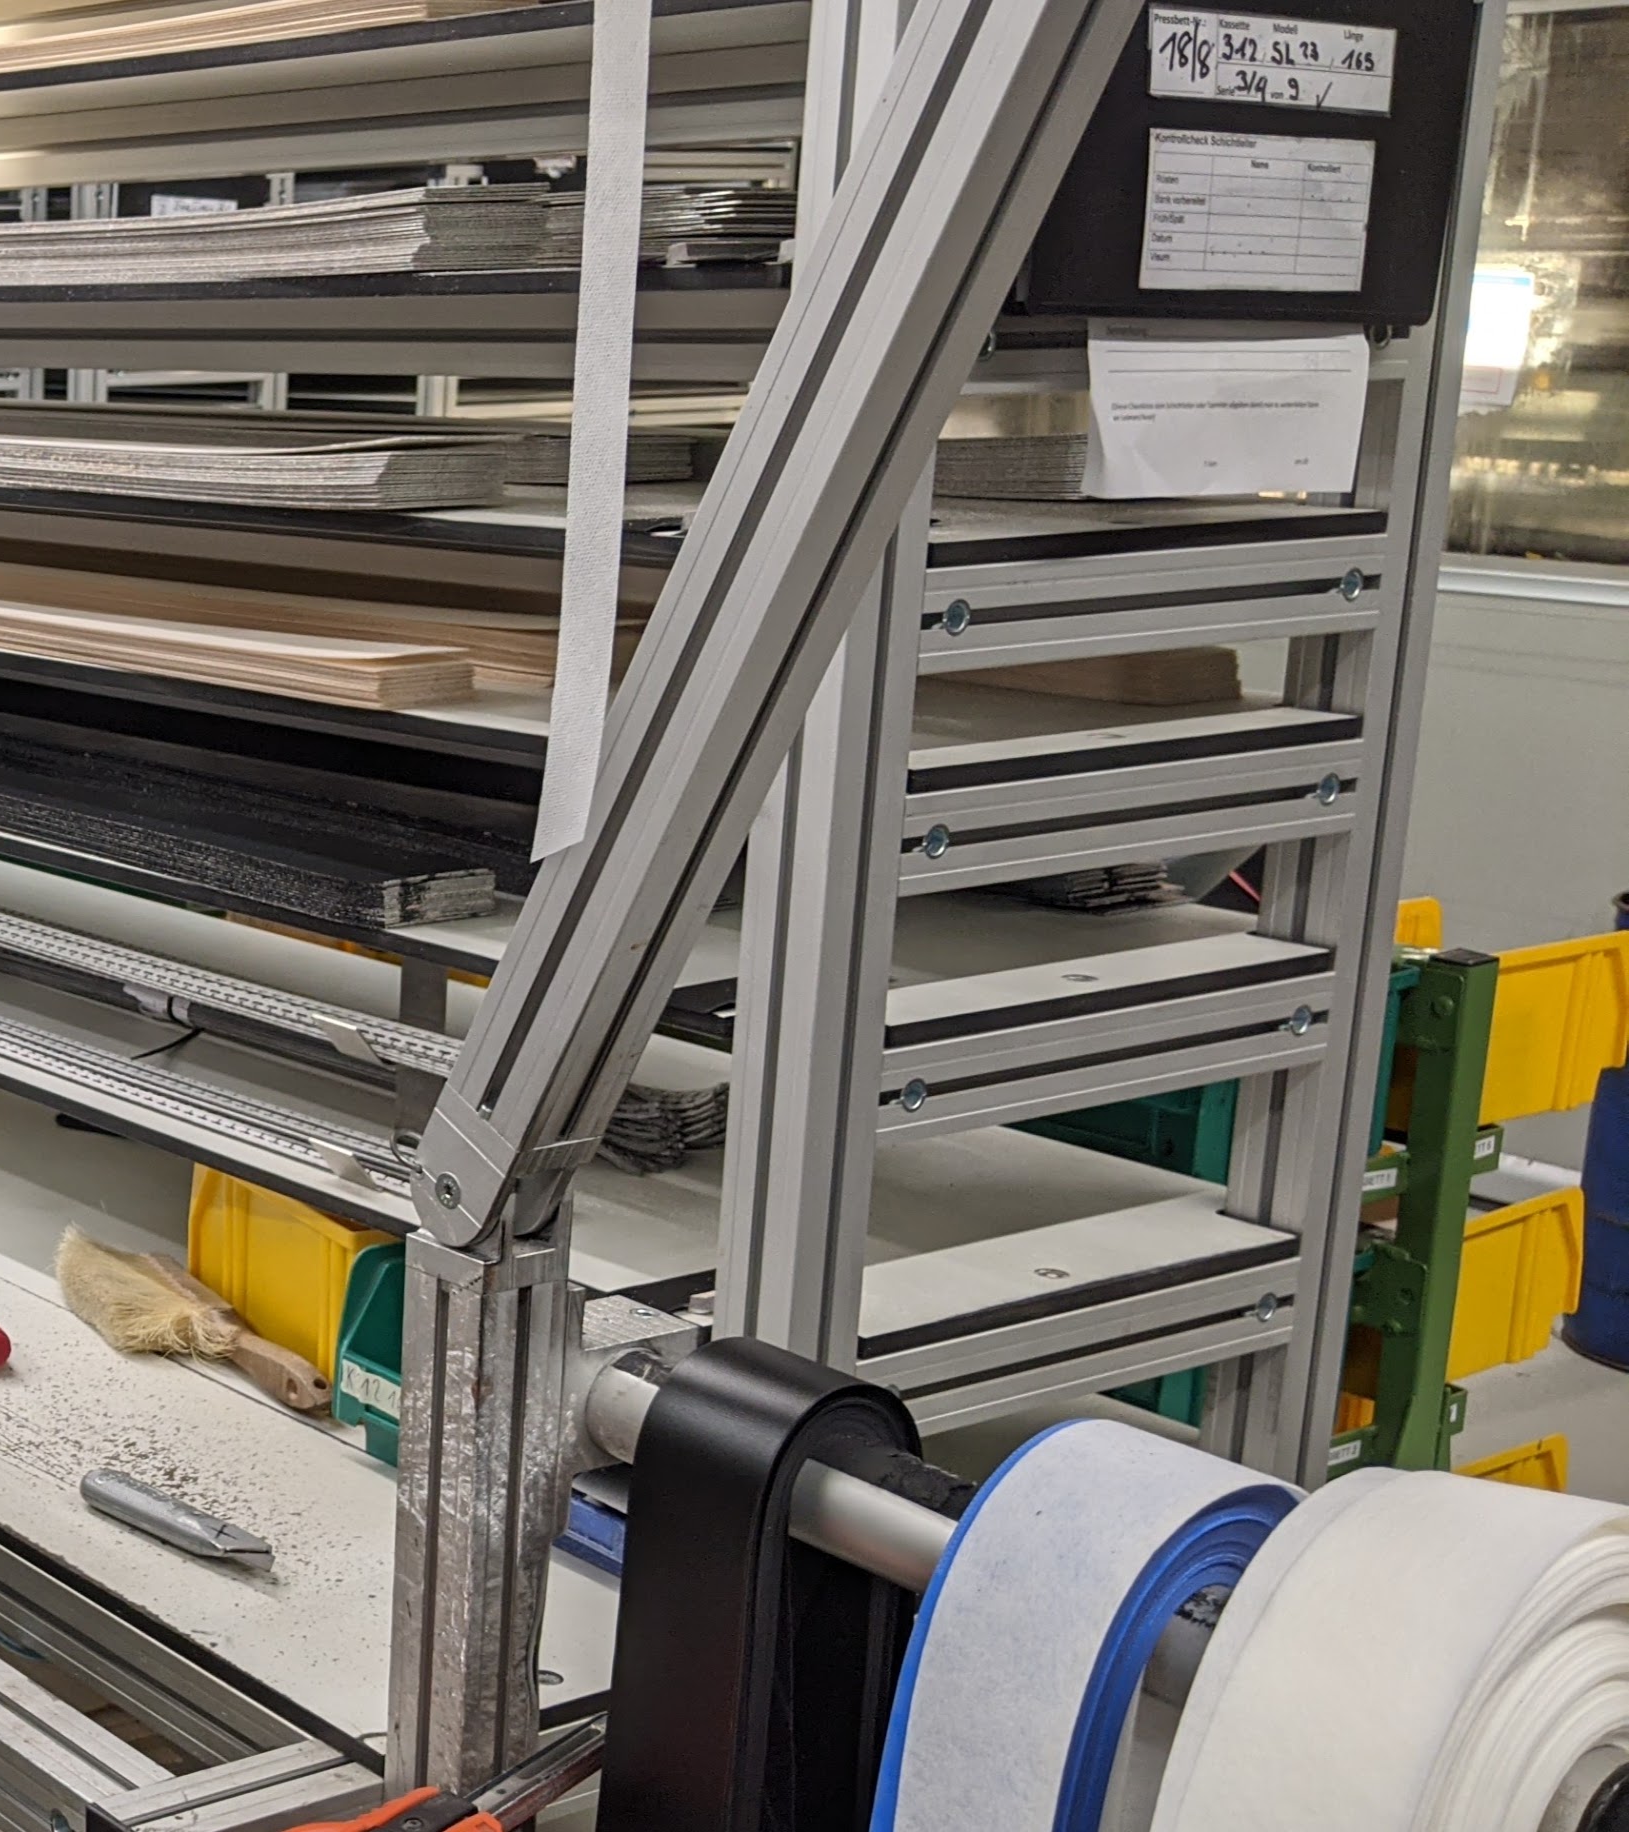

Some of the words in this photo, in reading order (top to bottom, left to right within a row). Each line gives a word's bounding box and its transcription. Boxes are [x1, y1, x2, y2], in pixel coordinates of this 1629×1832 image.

[1219, 19, 1251, 31] Kassette
[1273, 23, 1298, 35] Modell
[1221, 33, 1257, 62] 312
